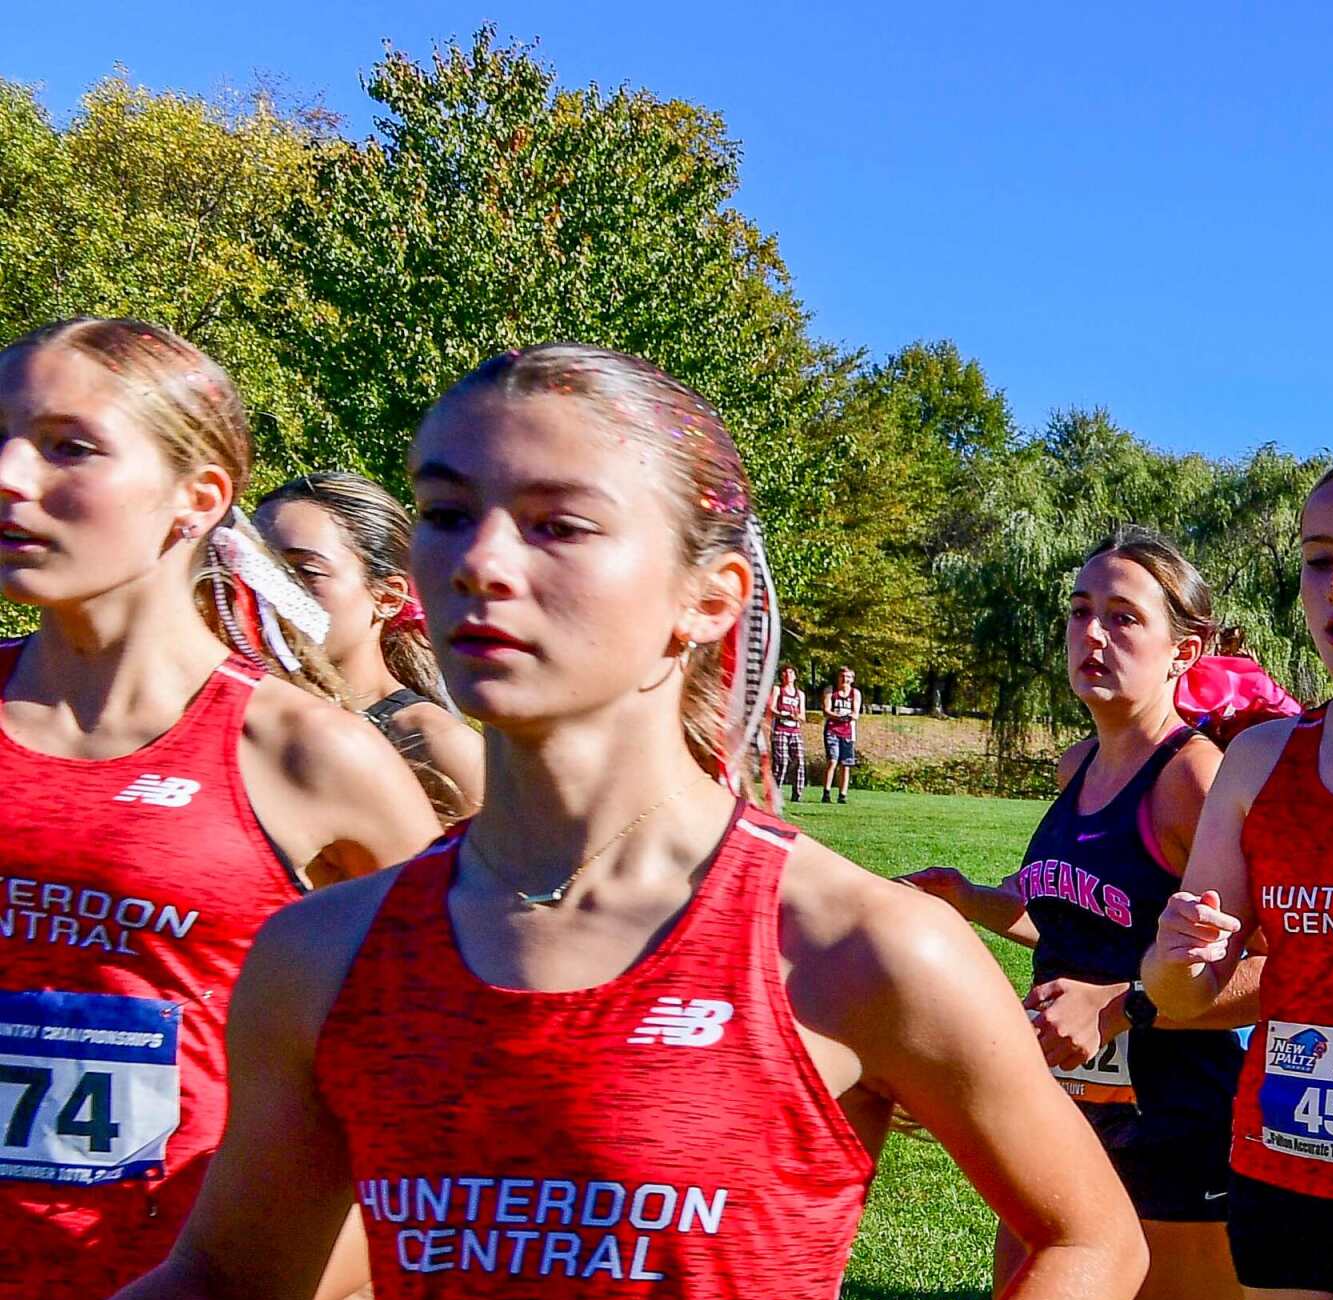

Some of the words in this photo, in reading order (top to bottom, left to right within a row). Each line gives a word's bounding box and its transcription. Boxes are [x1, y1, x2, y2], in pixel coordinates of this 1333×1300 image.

[0, 876, 199, 938] ERDON
[1275, 1040, 1305, 1054] NEW
[1275, 1053, 1315, 1067] PALTZ
[359, 1177, 728, 1235] HUNTERDON
[398, 1228, 665, 1281] CENTRAL
